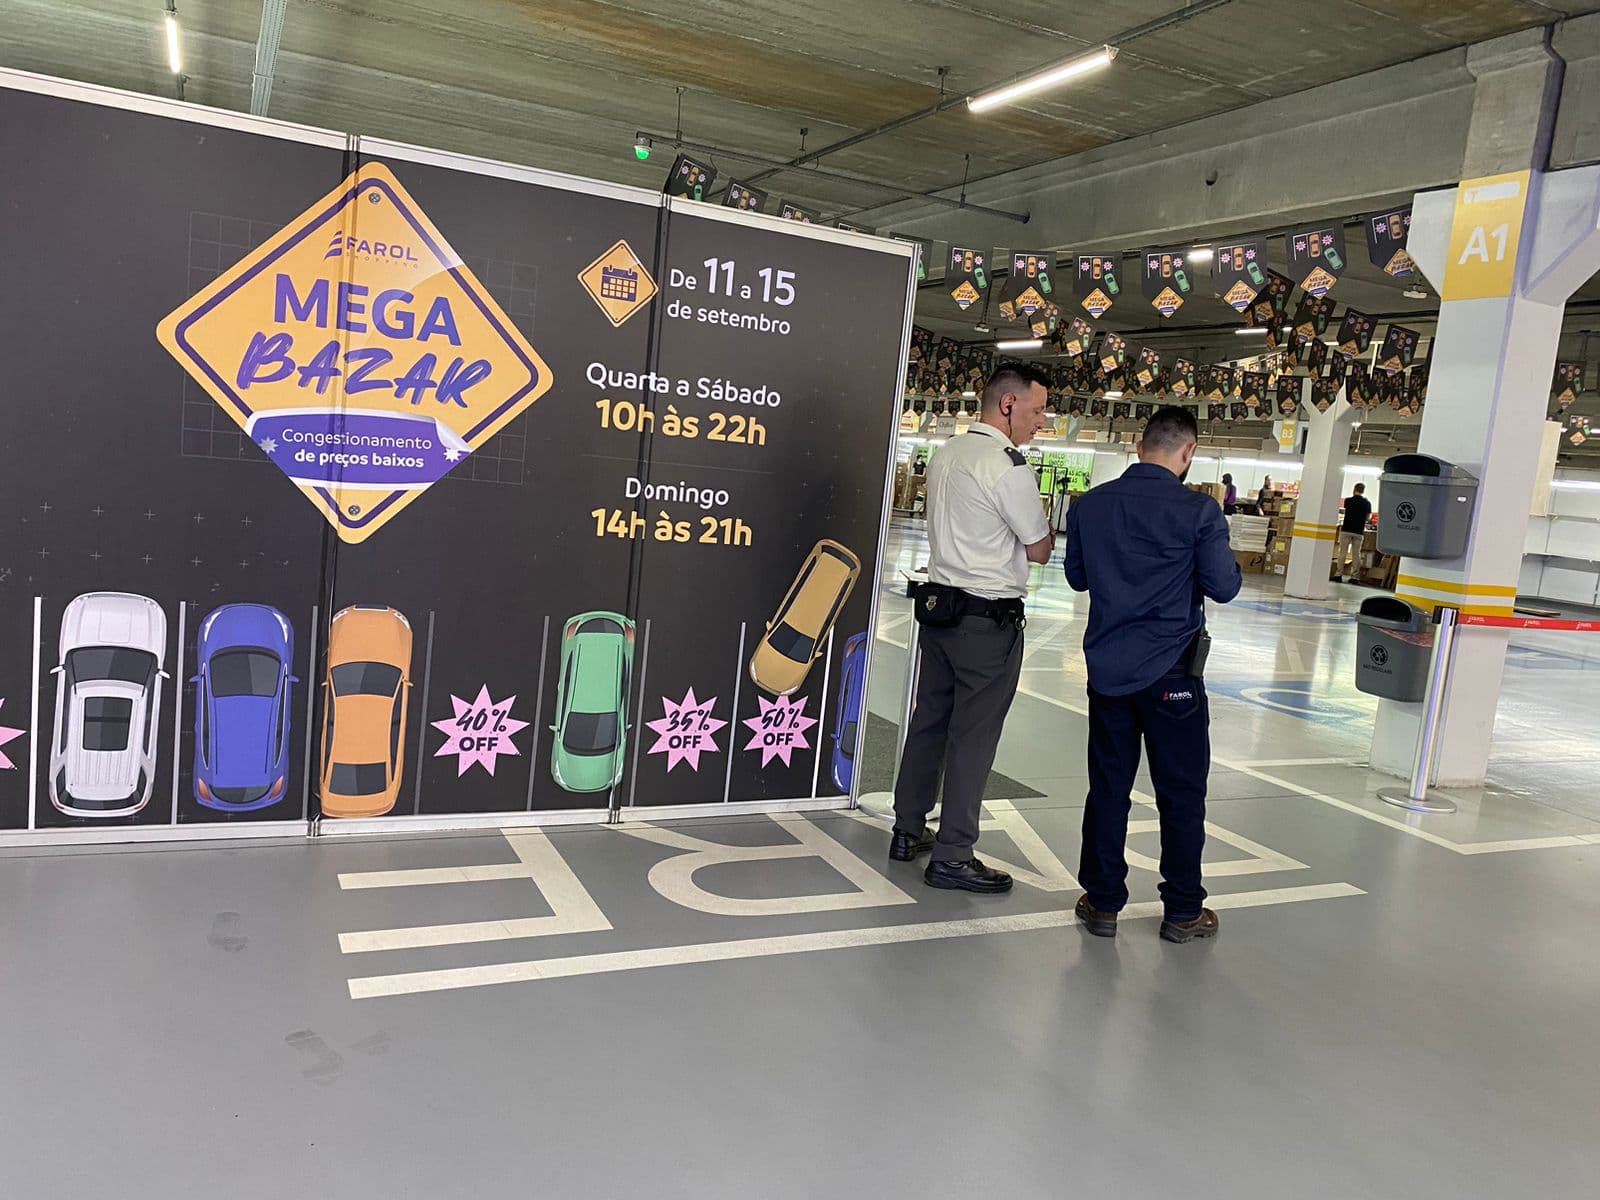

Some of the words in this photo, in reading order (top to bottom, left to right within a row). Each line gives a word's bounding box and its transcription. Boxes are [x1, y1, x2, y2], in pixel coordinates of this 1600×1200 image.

[346, 236, 418, 261] FAROL
[1458, 223, 1510, 265] A1
[669, 268, 697, 290] De
[703, 257, 735, 296] 11
[740, 285, 752, 299] a
[758, 267, 796, 306] 15
[274, 272, 462, 346] MEGA
[667, 300, 692, 319] de
[696, 308, 791, 335] setembro
[235, 331, 493, 409] BAZAR
[586, 362, 670, 393] Quarta
[676, 380, 690, 396] a
[696, 376, 781, 407] Sábado
[595, 399, 655, 433] 10h
[661, 404, 699, 438] às
[707, 412, 767, 446] 22h
[281, 428, 432, 451] Congestionamento
[294, 448, 316, 463] de
[319, 451, 369, 469] preços
[372, 451, 424, 468] baixos
[624, 477, 730, 509] Domingo
[590, 508, 646, 540] 14h
[653, 510, 691, 543] às
[698, 516, 753, 546] 21h
[456, 708, 508, 733] 40%
[665, 708, 711, 732] 35%
[760, 708, 801, 731] 50%
[458, 736, 499, 753] OFF
[668, 735, 702, 751] OFF
[763, 732, 795, 747] OFF
